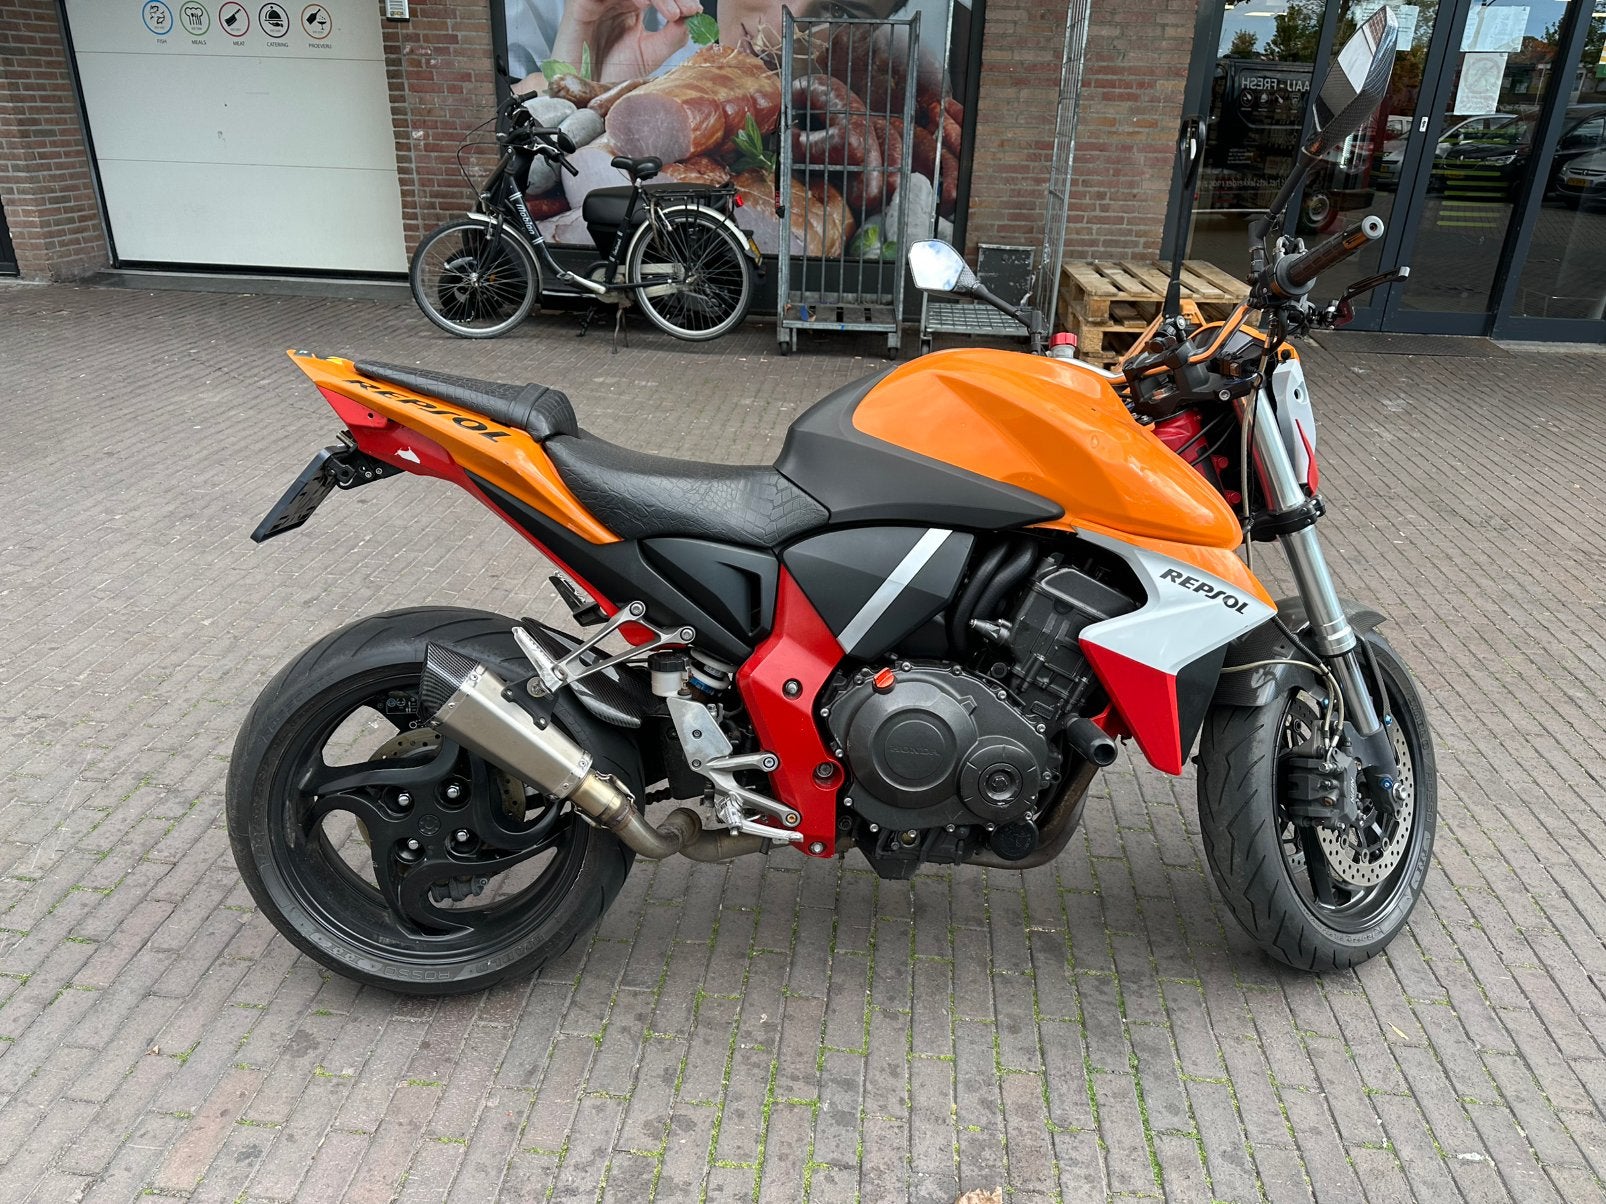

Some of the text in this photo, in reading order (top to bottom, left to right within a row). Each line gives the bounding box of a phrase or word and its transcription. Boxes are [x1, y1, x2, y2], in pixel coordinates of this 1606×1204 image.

[341, 378, 512, 444] REPSOL
[1158, 567, 1249, 616] REPSOL
[888, 744, 942, 758] HONDA
[384, 965, 451, 982] ROSSO
